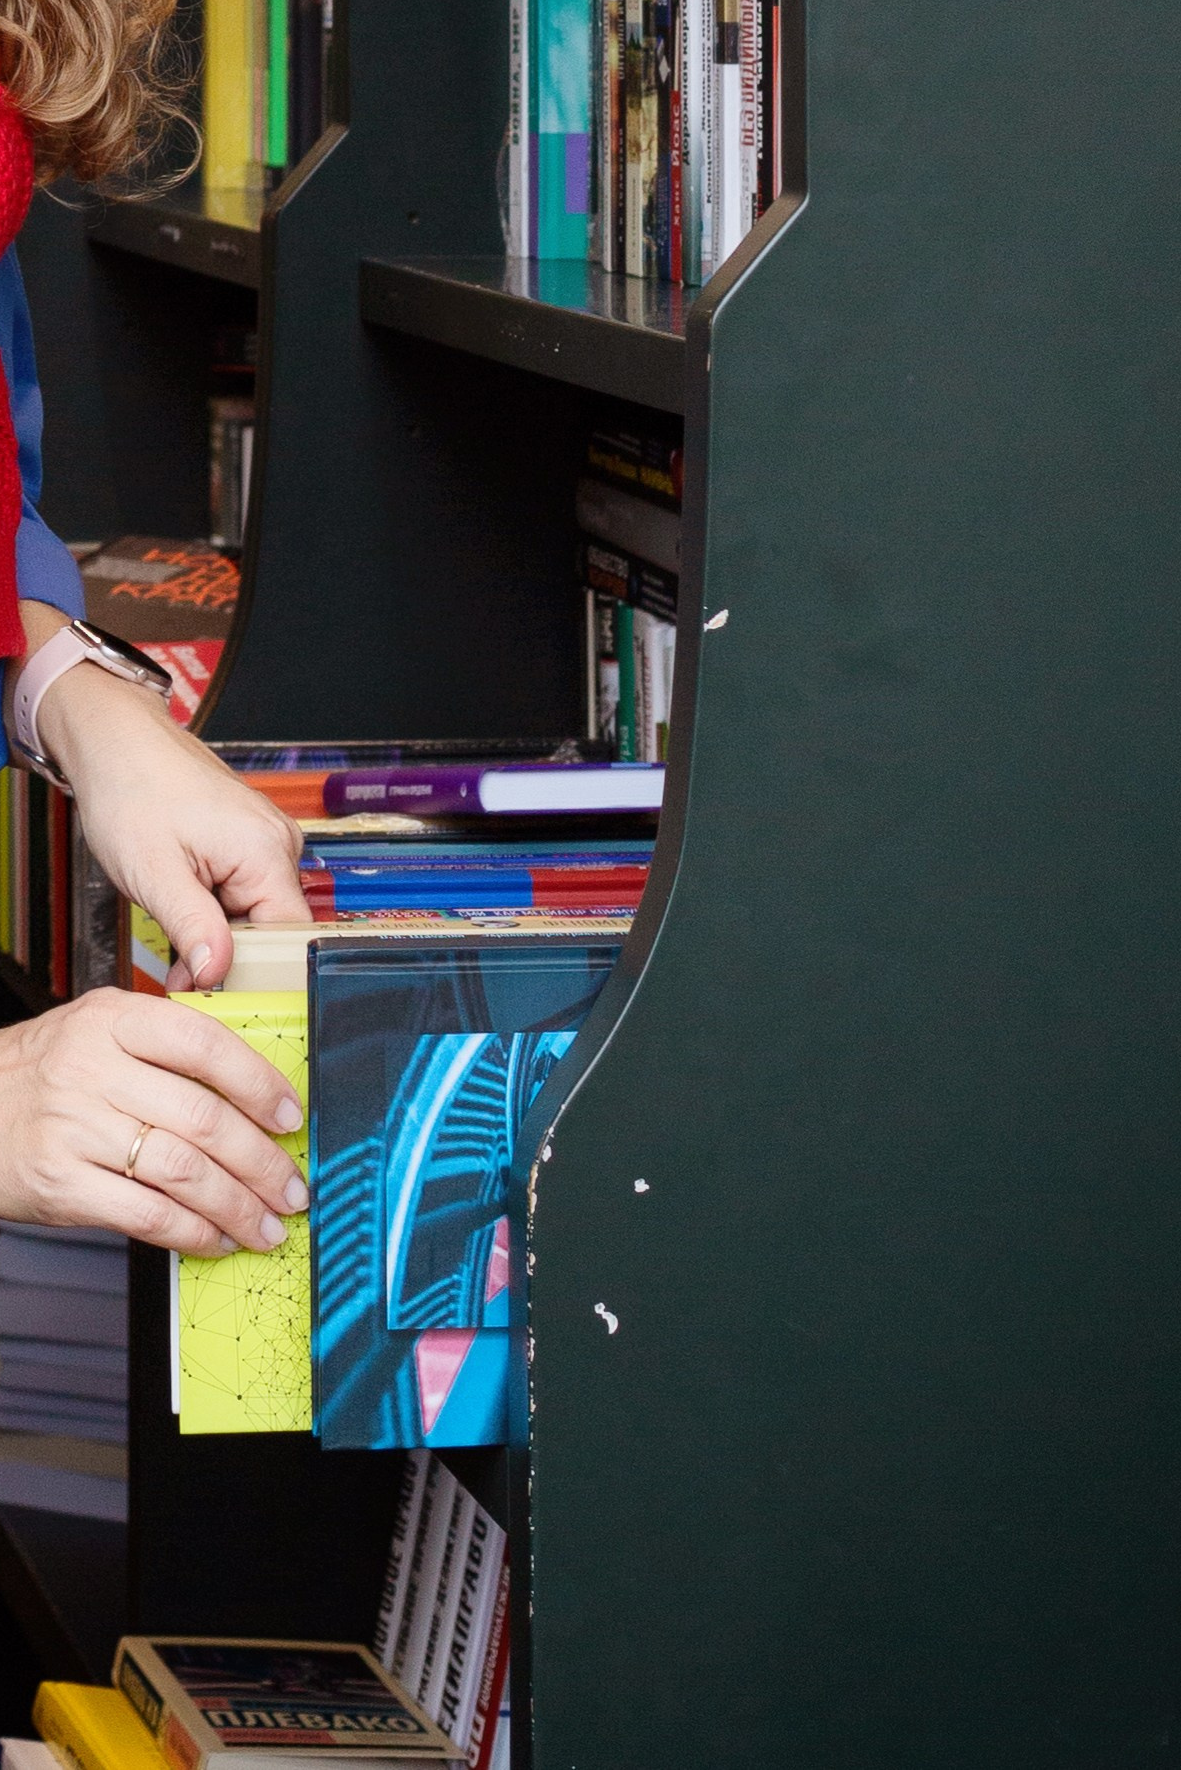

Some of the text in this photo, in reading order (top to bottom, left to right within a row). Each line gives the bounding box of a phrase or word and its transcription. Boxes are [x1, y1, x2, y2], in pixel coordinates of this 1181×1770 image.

[671, 104, 680, 167] Йоас
[682, 59, 690, 166] Дорожная
[740, 110, 755, 147] БЕЗ
[206, 1709, 420, 1734] ПЛЕВАКО
